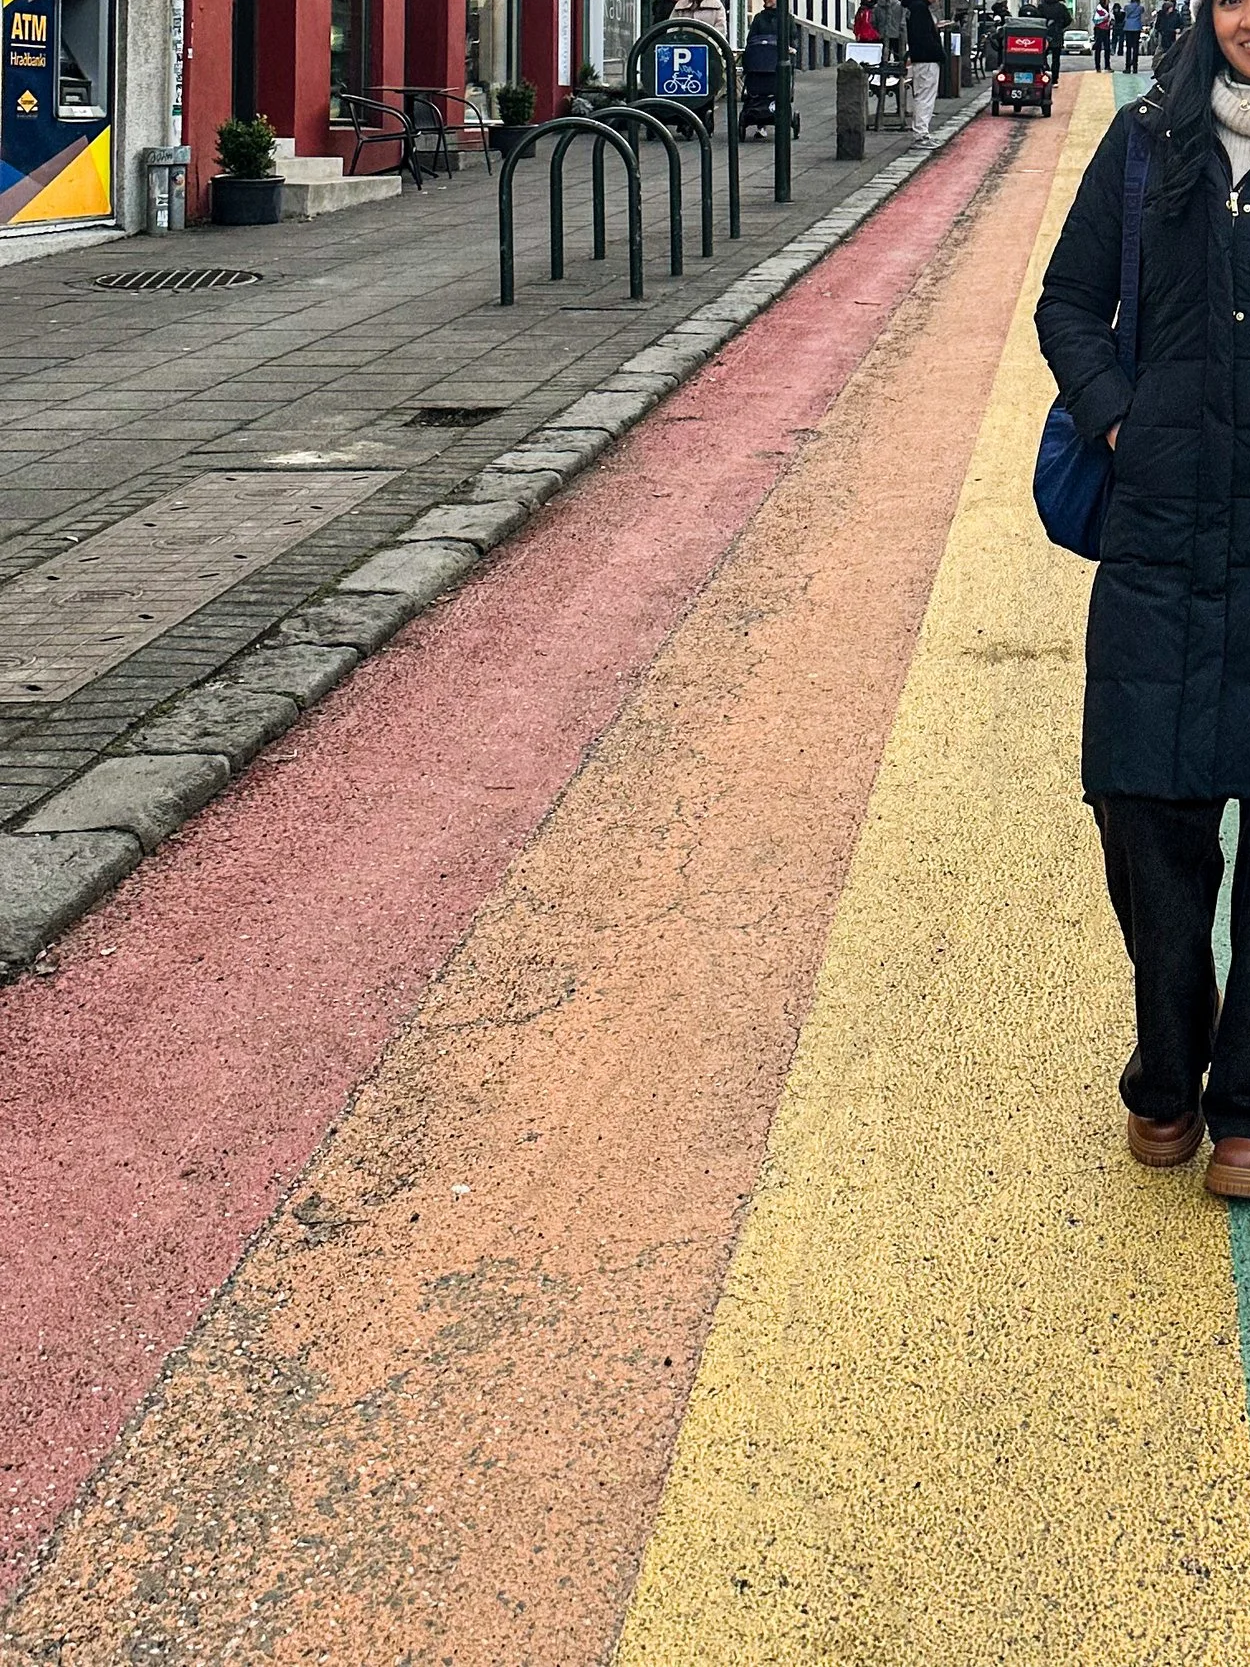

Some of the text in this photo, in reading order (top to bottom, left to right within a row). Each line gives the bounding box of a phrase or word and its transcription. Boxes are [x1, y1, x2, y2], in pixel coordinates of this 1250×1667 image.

[11, 12, 47, 42] ATM
[10, 51, 46, 67] Hraðbanki
[673, 48, 692, 71] P
[1011, 90, 1022, 98] 53
